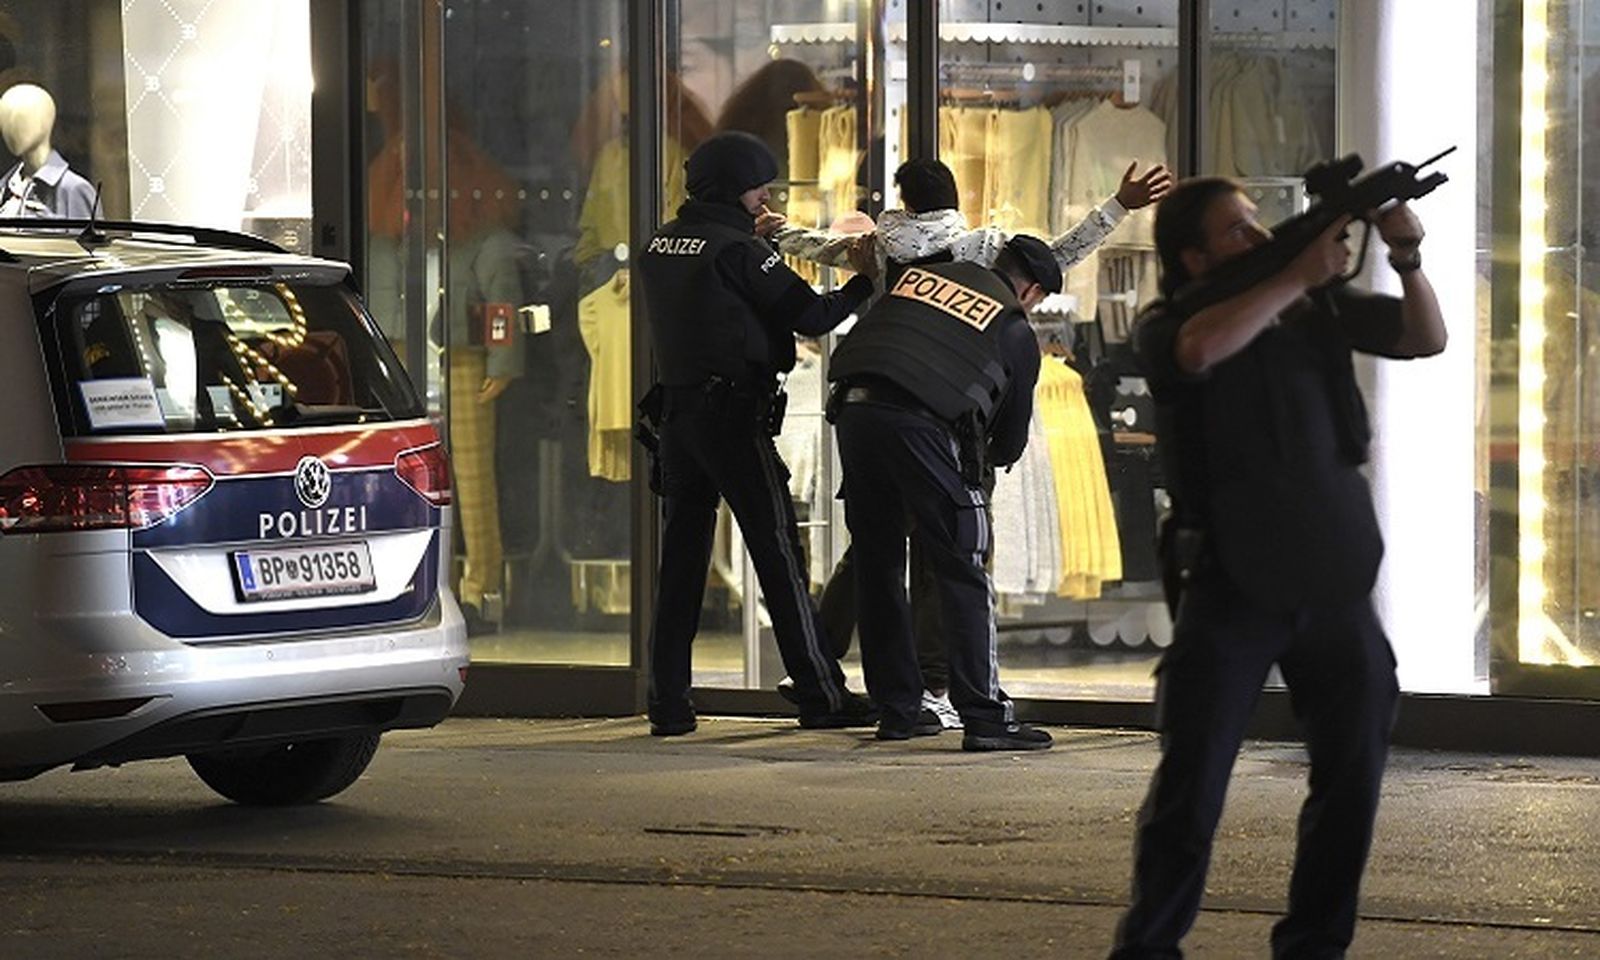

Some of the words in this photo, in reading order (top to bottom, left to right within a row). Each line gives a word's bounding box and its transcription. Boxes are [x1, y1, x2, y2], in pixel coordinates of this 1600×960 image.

[648, 237, 707, 255] POLIZEI
[897, 270, 997, 325] POLIZEI
[259, 505, 366, 538] POLIZEI
[258, 556, 284, 586] BP
[300, 551, 362, 583] 91358
